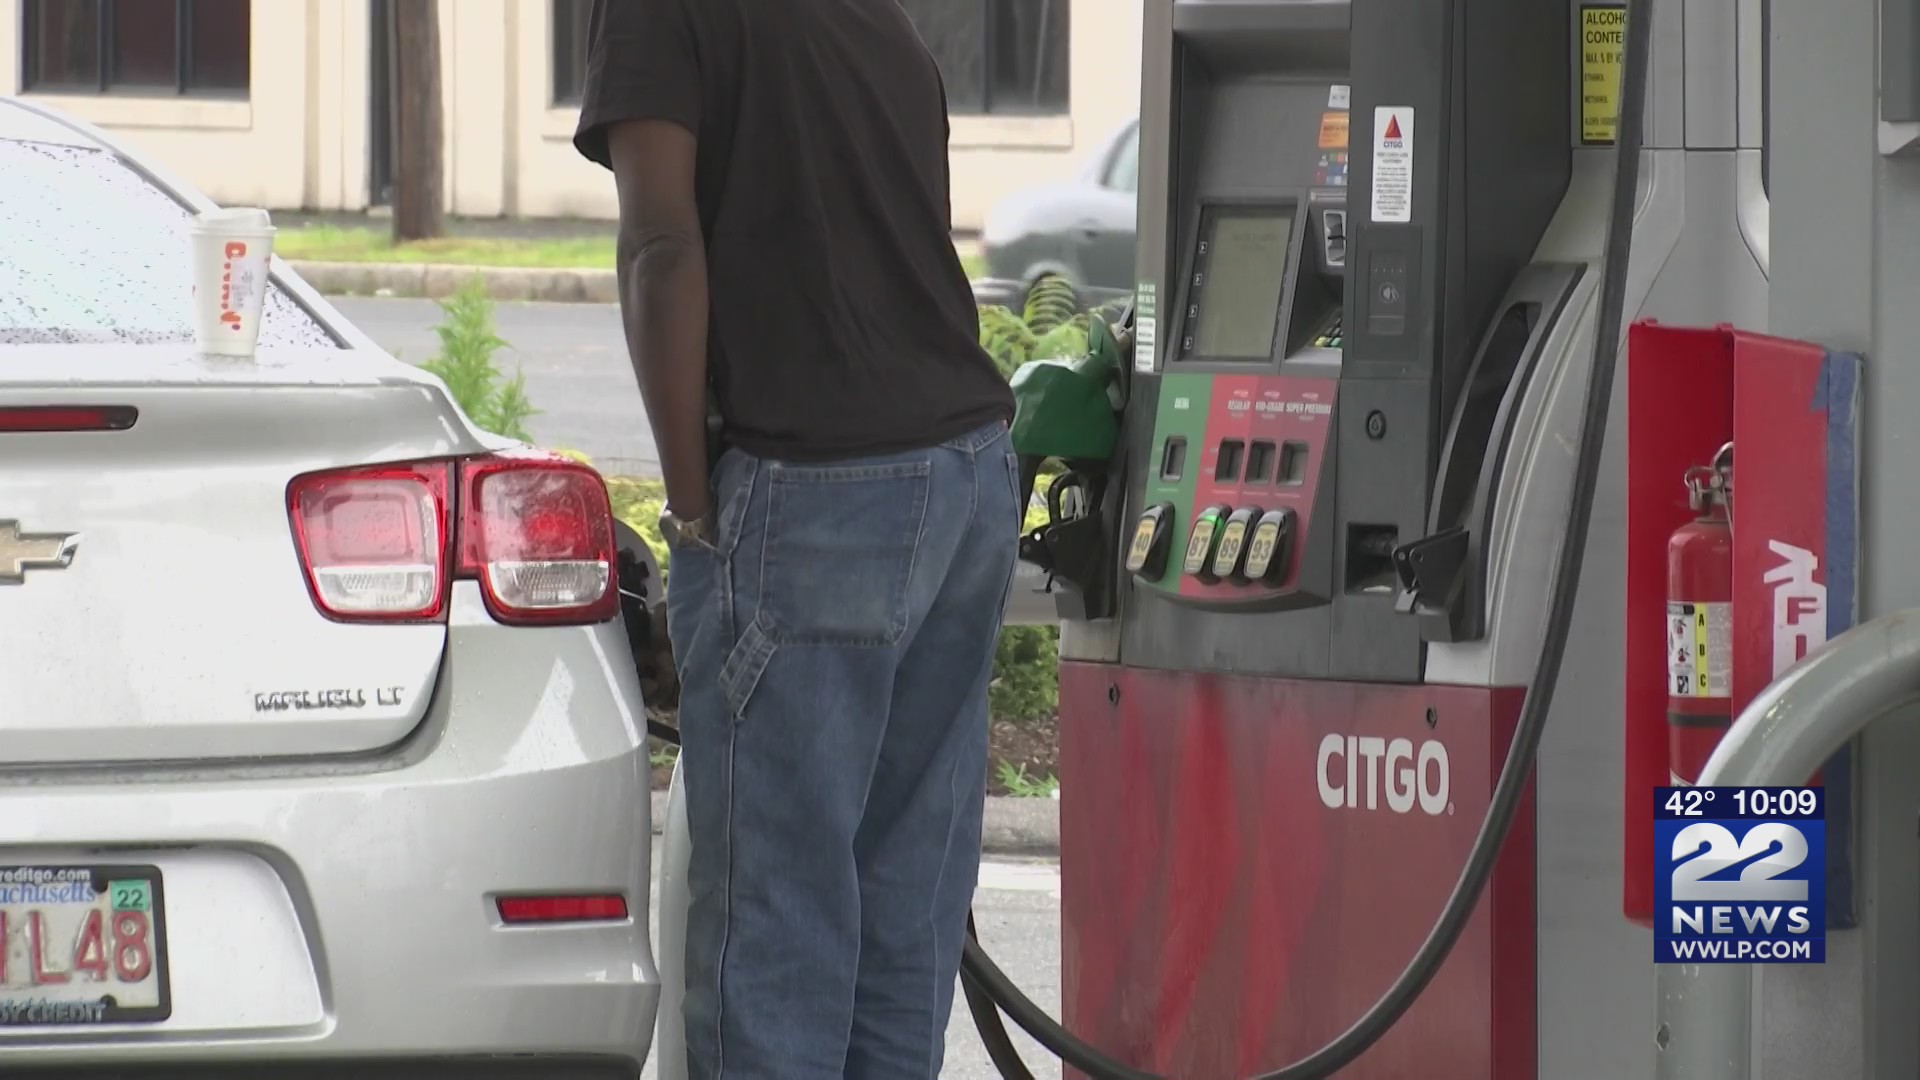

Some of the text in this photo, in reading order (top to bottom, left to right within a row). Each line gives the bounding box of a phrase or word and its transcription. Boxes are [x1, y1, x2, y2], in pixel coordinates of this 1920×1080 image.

[1586, 31, 1625, 43] CONTE
[1189, 536, 1208, 556] 87
[1219, 538, 1239, 558] 89
[1251, 540, 1272, 561] 93
[254, 686, 405, 712] MALIBU LT
[1316, 733, 1450, 815] CITGO
[117, 889, 144, 908] 22
